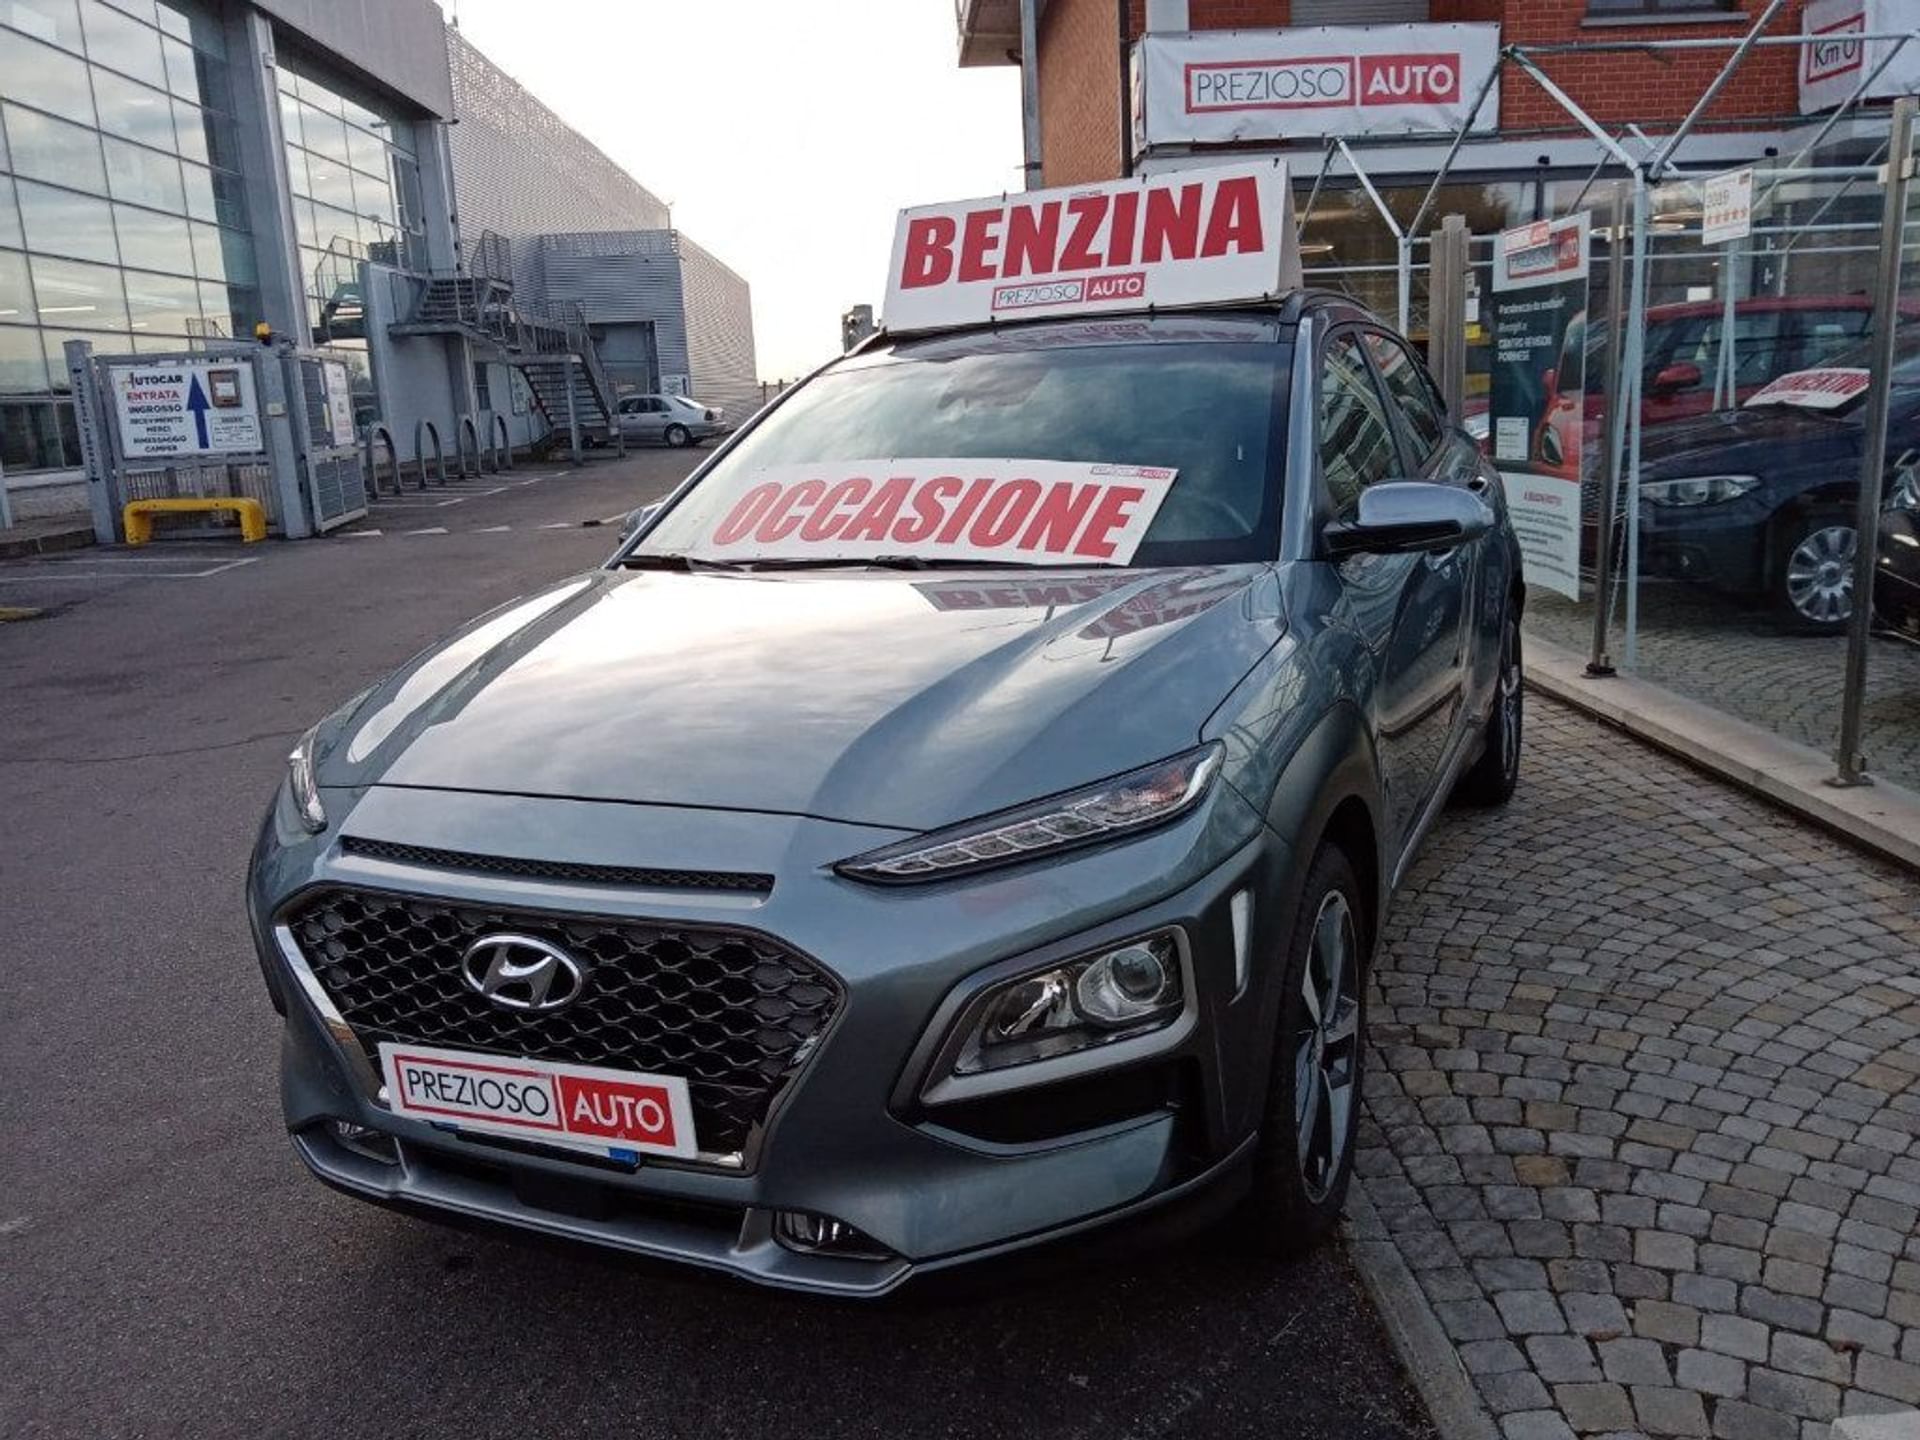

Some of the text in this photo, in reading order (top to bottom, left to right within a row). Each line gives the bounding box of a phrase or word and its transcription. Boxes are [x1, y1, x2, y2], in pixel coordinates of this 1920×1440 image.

[1196, 63, 1455, 103] PREZIOSO AUTO
[900, 175, 1264, 290] BENZINA
[998, 277, 1142, 306] PREZIOSO AUTO
[123, 372, 184, 388] AUTOCAR
[127, 390, 181, 401] ENTRATA
[128, 403, 183, 414] INGROSSO
[712, 476, 1145, 559] OCCASIONE
[406, 1068, 665, 1132] PREZIOSO AUTO
